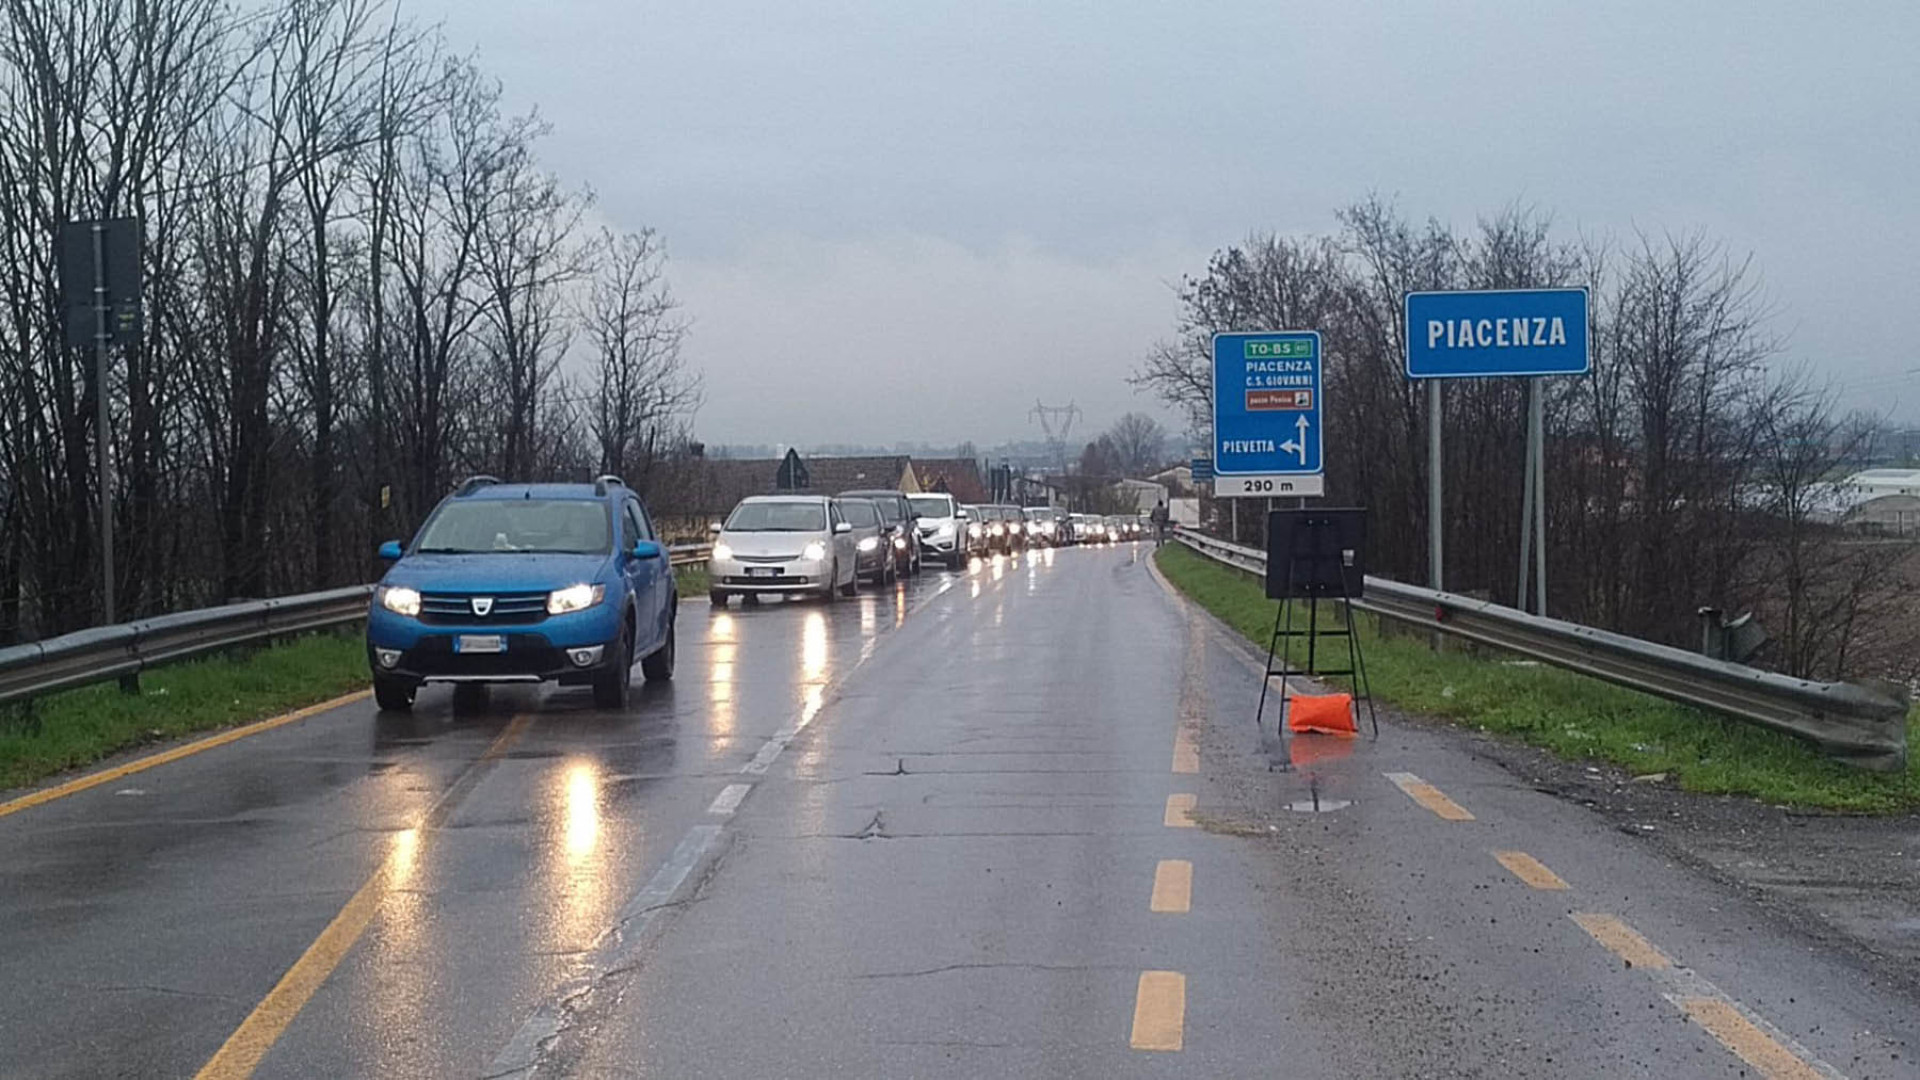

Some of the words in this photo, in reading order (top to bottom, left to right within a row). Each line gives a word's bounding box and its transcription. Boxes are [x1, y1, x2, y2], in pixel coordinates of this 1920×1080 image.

[1427, 316, 1567, 349] PIACENZA
[1250, 343, 1291, 354] TO-BS
[1246, 361, 1312, 372] PIACENZA
[1246, 375, 1265, 387] C.S.
[1265, 374, 1313, 386] GIOVANNI
[1222, 439, 1276, 453] PIEVETTA
[1243, 479, 1273, 492] 290
[1280, 481, 1294, 492] m
